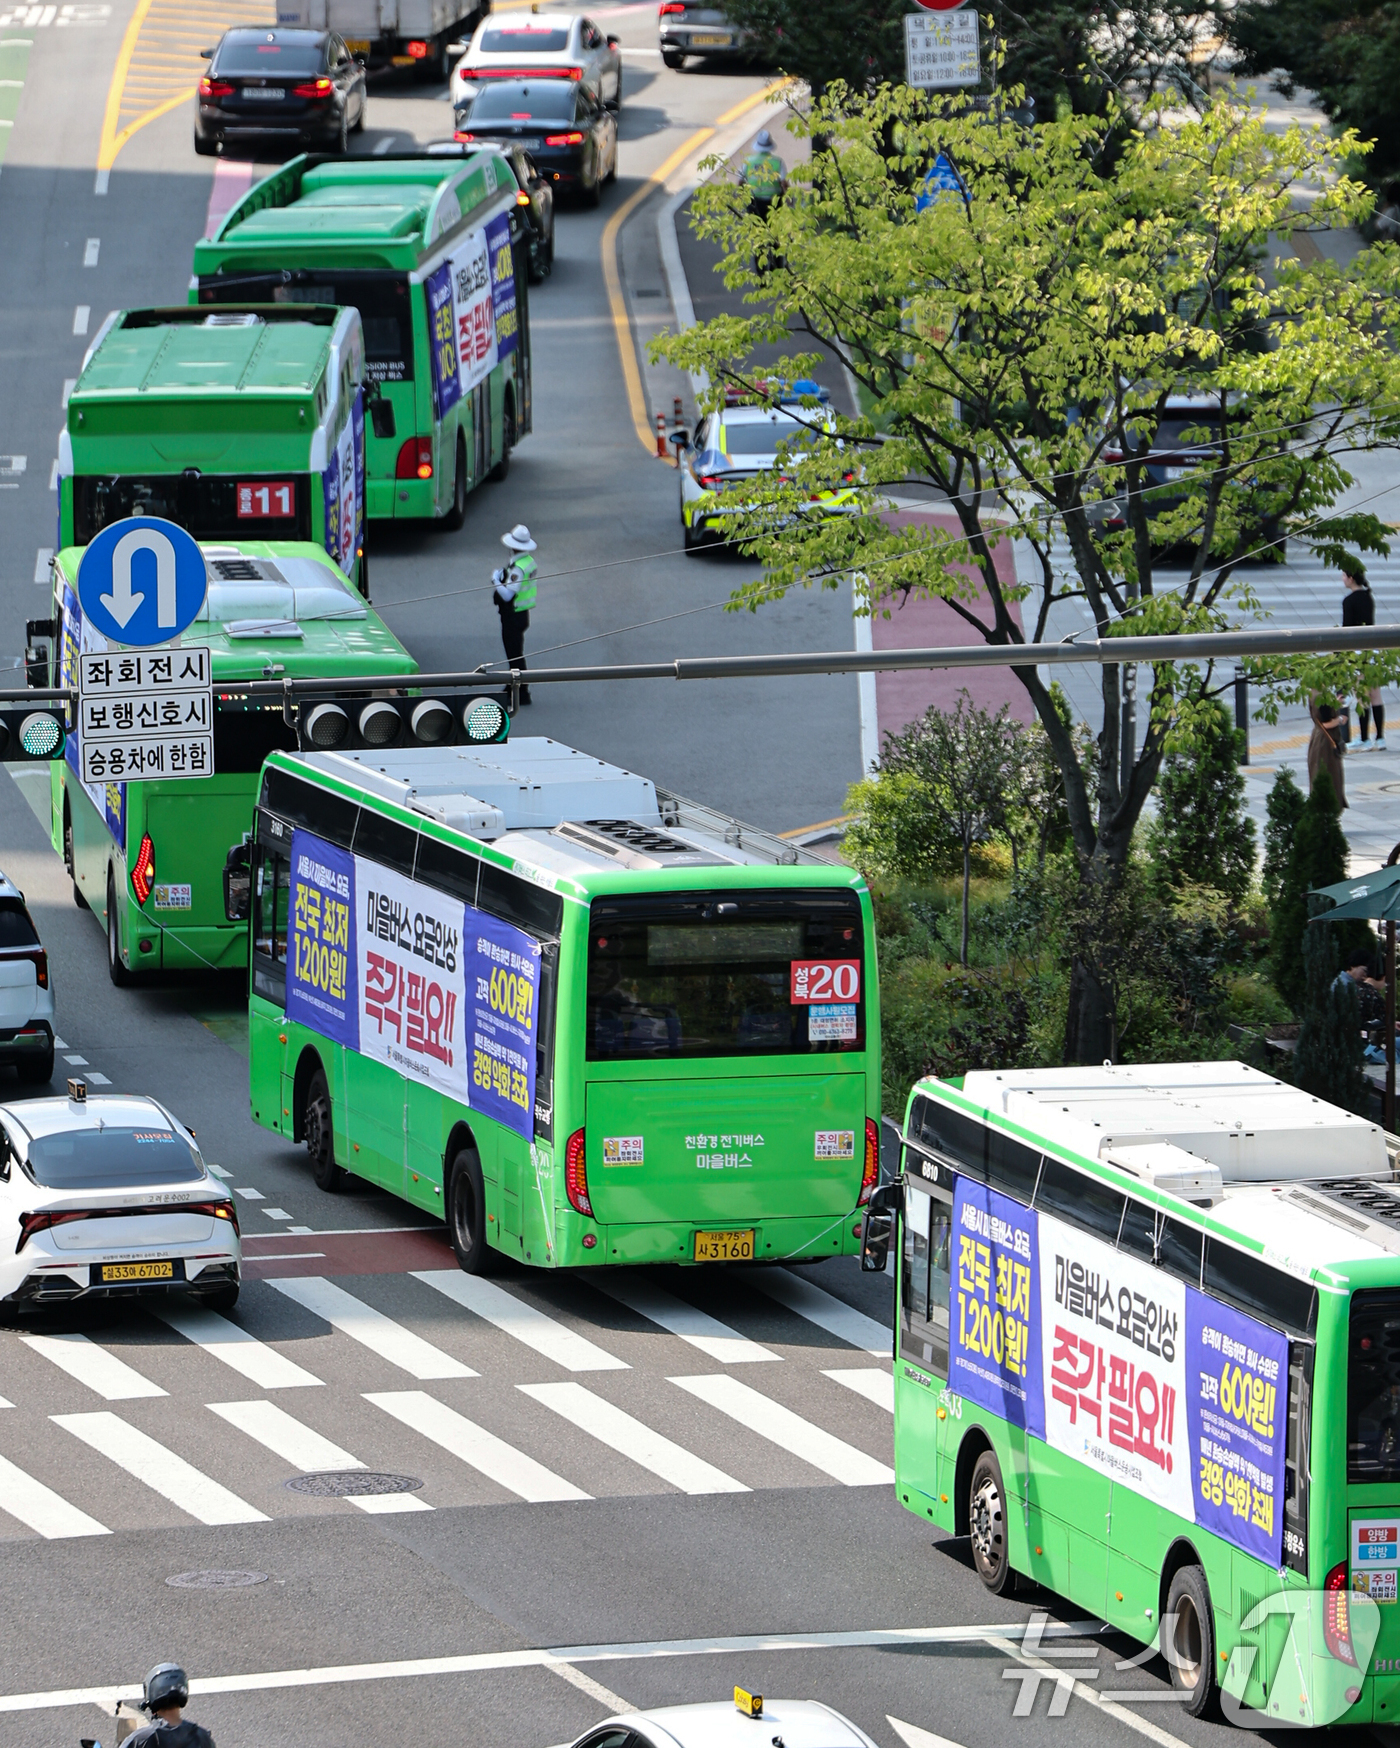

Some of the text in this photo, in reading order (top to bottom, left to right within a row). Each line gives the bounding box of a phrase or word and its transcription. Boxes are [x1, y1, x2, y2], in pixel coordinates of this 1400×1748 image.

[255, 486, 290, 514] 11
[88, 654, 203, 686] 좌회전시
[88, 698, 206, 729] 보행신호시
[89, 742, 206, 776] 승용차에 한함
[271, 820, 283, 837] 3160
[295, 883, 349, 952] 전국 최저
[367, 890, 458, 974] 마을버스 요금인상
[294, 932, 347, 1001] 1,200원!
[794, 965, 858, 999] 성북 20
[365, 950, 457, 1068] 즉각 필요!!
[475, 976, 490, 1004] 고작
[490, 967, 533, 1030] 600원!
[473, 1049, 491, 1091] 경영
[493, 1056, 511, 1100] 악화
[621, 1139, 641, 1150] 주의
[685, 1133, 765, 1149] 친환경 전기버스
[817, 1134, 836, 1144] 주의
[697, 1153, 752, 1169] 마을버스
[922, 1160, 938, 1182] 6810
[710, 1232, 740, 1241] 서울 75
[961, 1203, 983, 1236] 서울시
[983, 1214, 1013, 1249] 마을버스
[139, 1264, 168, 1277] 6702
[959, 1234, 1031, 1321] 전국 최저
[1055, 1254, 1178, 1363] 마을버스 요금인상
[958, 1291, 1028, 1378] 1,200원!
[1201, 1325, 1279, 1381] 승객이 환승하면 회사 수입은
[1051, 1325, 1106, 1439] 즉각
[1108, 1354, 1176, 1475] 필요!!
[1200, 1371, 1218, 1406] 고작
[1220, 1362, 1276, 1439] 600원!
[1200, 1436, 1212, 1457] 매년
[1260, 1471, 1274, 1493] 발생
[1200, 1456, 1274, 1537] 경영 악화 초래
[1368, 1529, 1388, 1542] 양방
[1368, 1545, 1388, 1559] 한방
[1372, 1573, 1396, 1585] 주의
